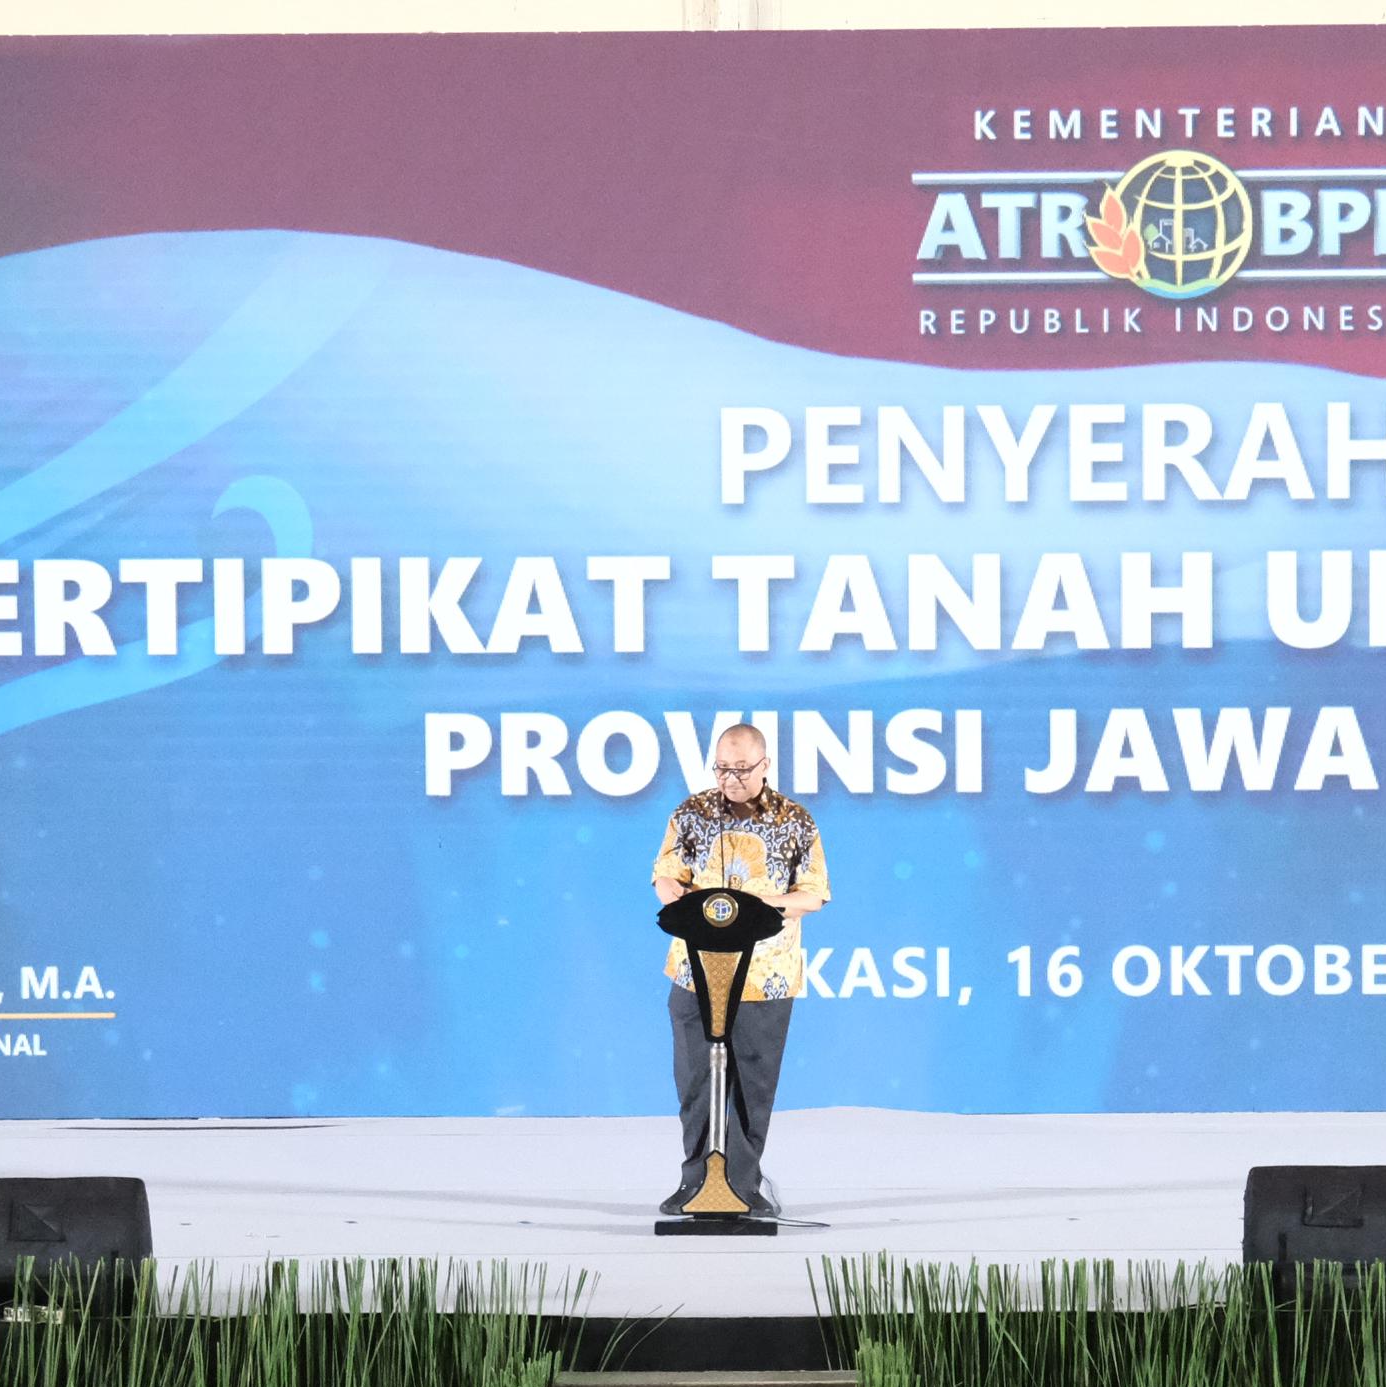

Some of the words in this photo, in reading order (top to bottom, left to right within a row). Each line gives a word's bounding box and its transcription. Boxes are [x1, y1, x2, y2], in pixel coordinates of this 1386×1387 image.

[974, 106, 1384, 140] KEMENTERIAN
[916, 192, 1089, 260] ATR
[919, 307, 1141, 335] REPUBLIK
[712, 552, 1212, 651] TANAH
[425, 710, 982, 796] PROVINSI
[1026, 707, 1378, 793] JAWA
[21, 966, 115, 1000] M.A.
[797, 946, 972, 1006] KASI,
[1008, 946, 1082, 997] 16
